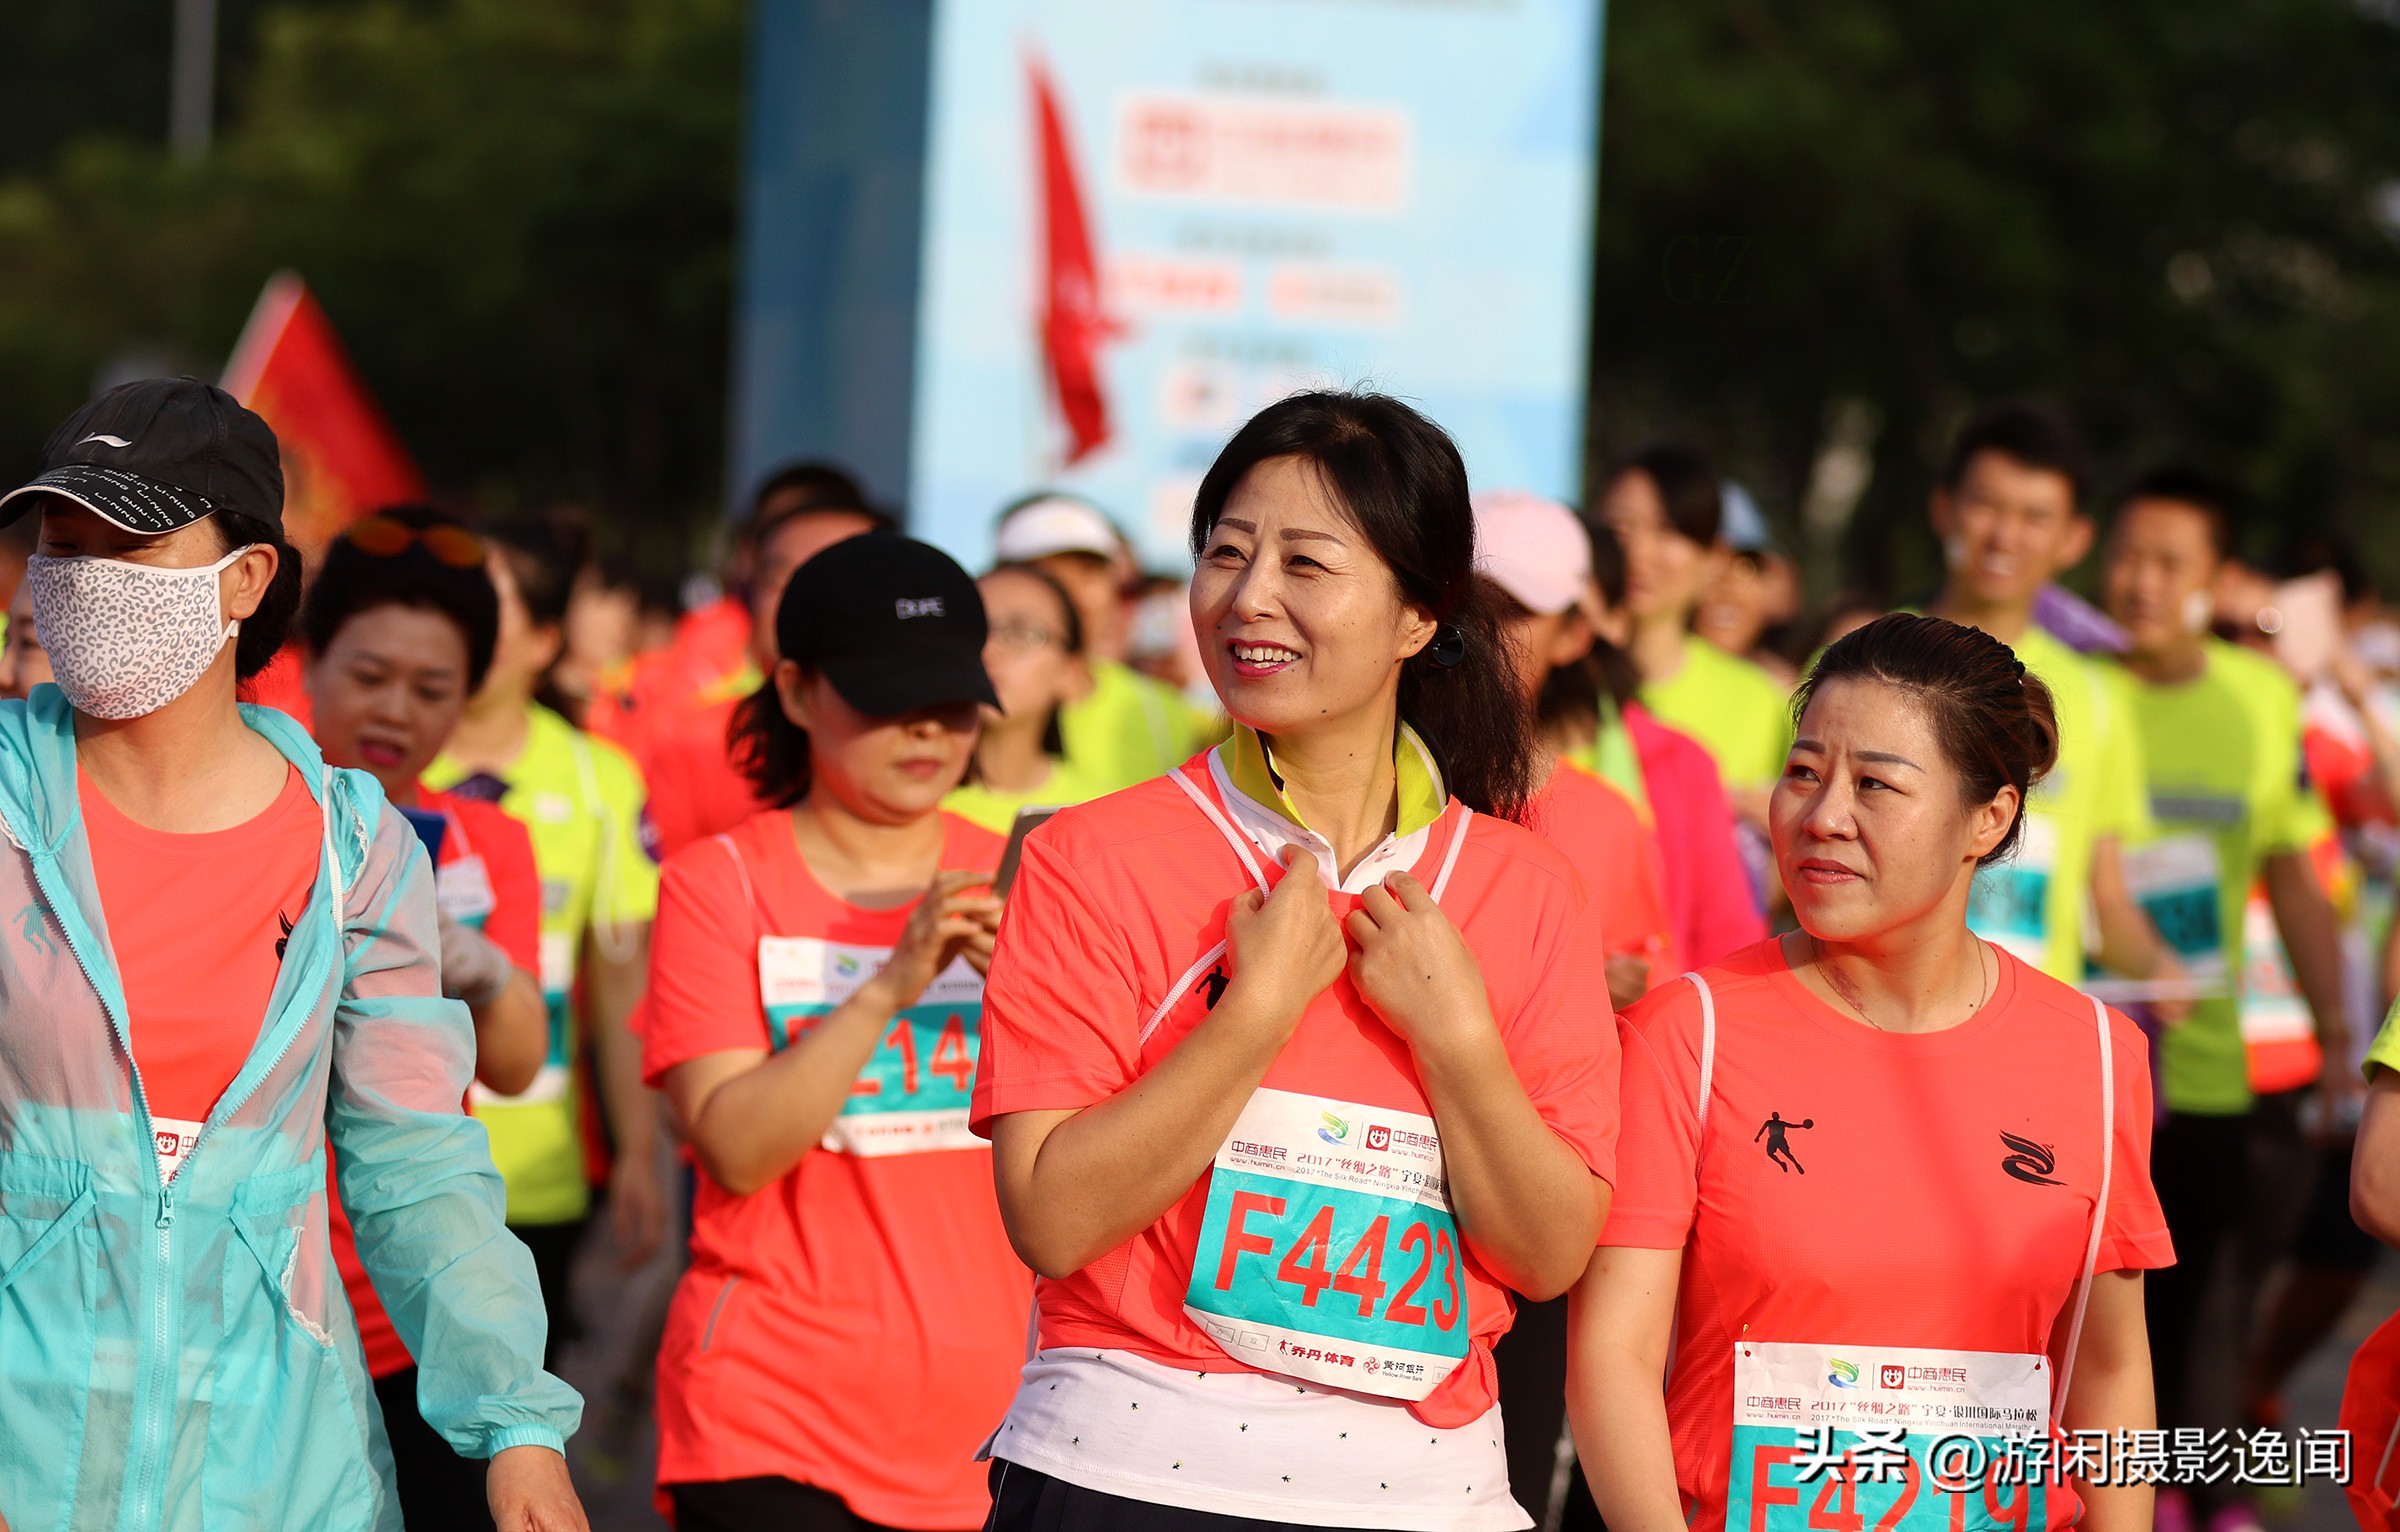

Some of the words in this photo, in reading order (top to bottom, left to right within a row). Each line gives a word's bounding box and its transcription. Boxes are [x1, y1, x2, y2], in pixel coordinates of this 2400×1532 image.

[1231, 1140, 1287, 1161] 中商惠民
[1229, 1156, 1285, 1171] www.huimin.cn
[1296, 1166, 1315, 1176] 2017
[1334, 1172, 1347, 1181] Silk
[1373, 1180, 1400, 1190] Ningxia
[1213, 1189, 1461, 1333] F4423
[1381, 1370, 1399, 1378] Yellow
[1383, 1359, 1425, 1375] 黄河银行
[1907, 1366, 1967, 1383] 中商惠民
[1906, 1384, 1966, 1393] www.huimin.cn
[1746, 1396, 1801, 1411] 中商惠民
[1745, 1412, 1801, 1420] www.huimin.cn
[1852, 1415, 1866, 1423] Silk
[1894, 1418, 1923, 1426] Ningxia
[1924, 1419, 1958, 1427] Yinchuan
[1959, 1421, 2004, 1430] International
[1750, 1444, 2030, 1532] F4219
